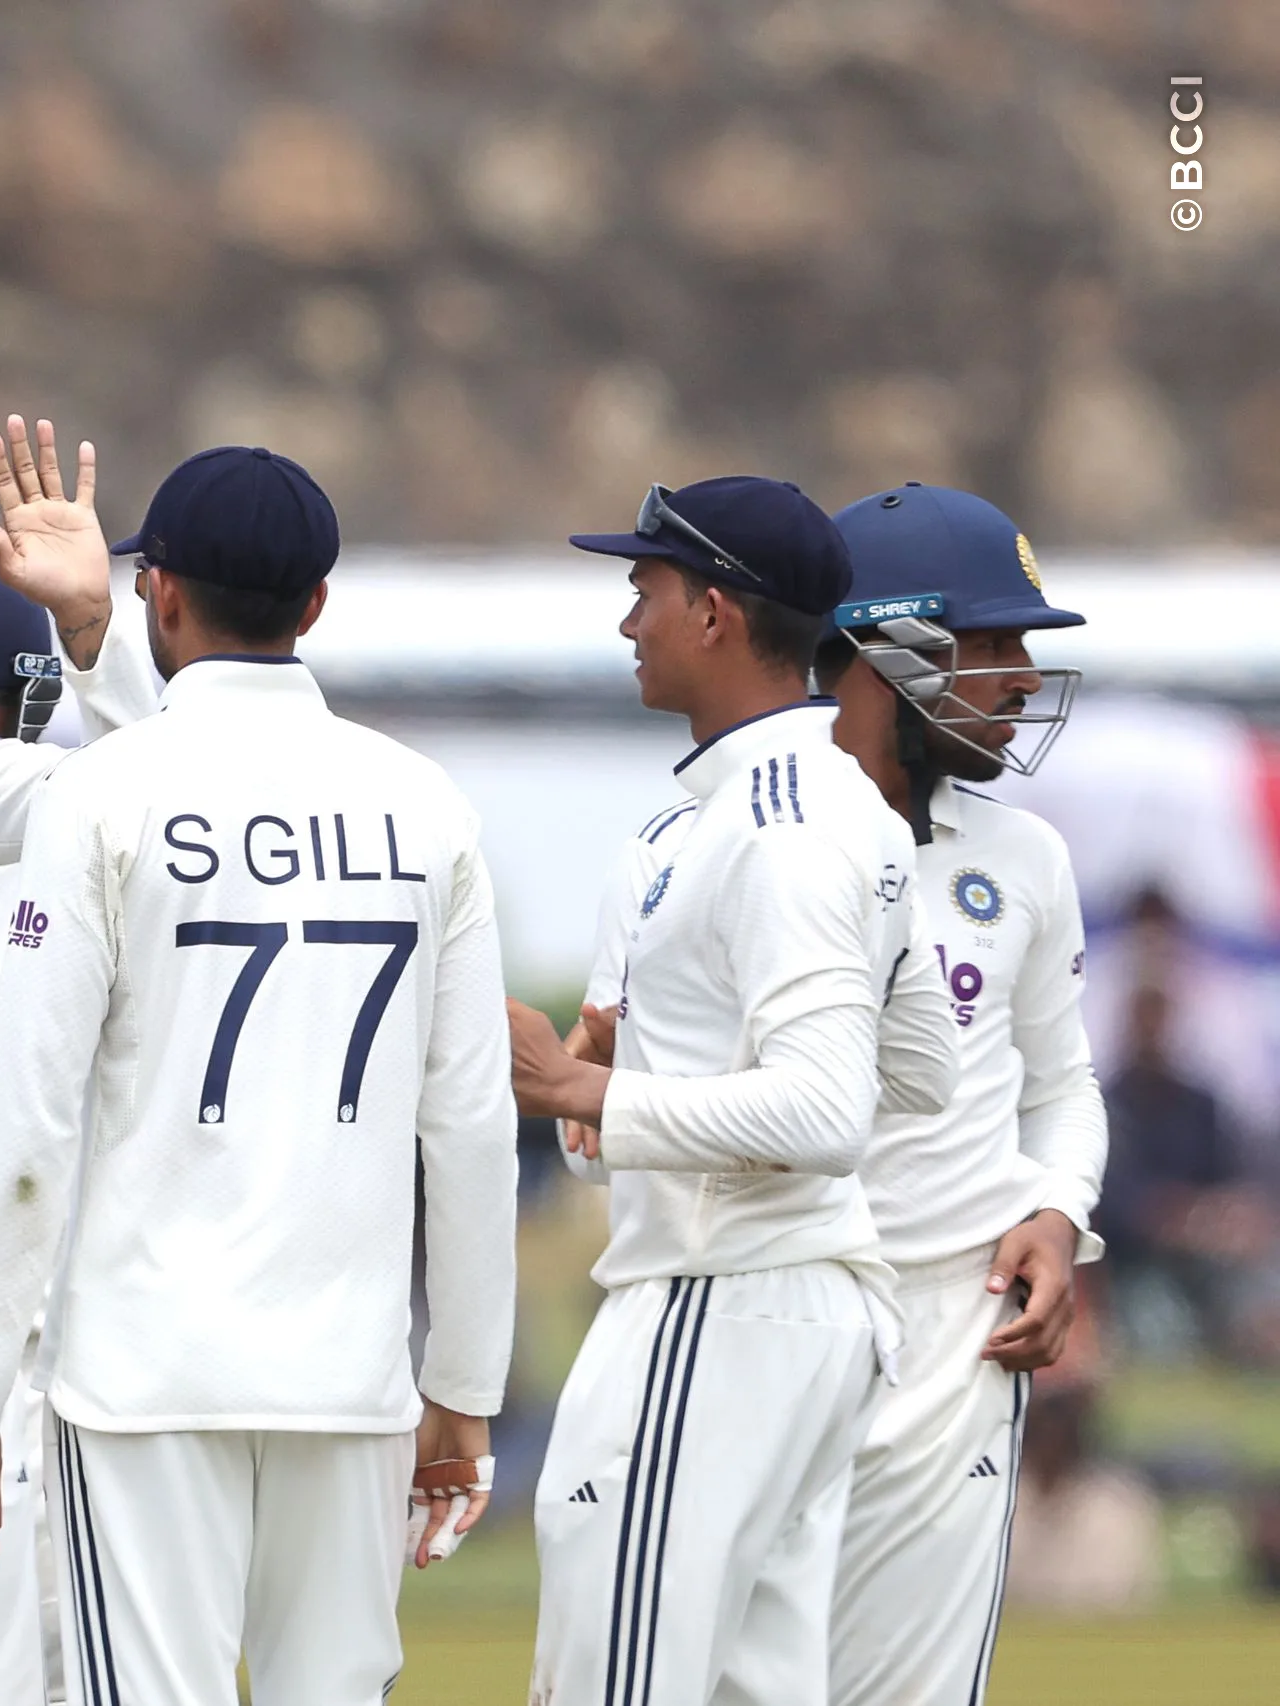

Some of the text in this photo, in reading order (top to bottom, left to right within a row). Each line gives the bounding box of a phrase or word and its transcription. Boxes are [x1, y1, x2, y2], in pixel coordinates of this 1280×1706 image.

[869, 600, 921, 618] SHREY
[164, 813, 426, 886] S GILL
[175, 920, 419, 1124] 77
